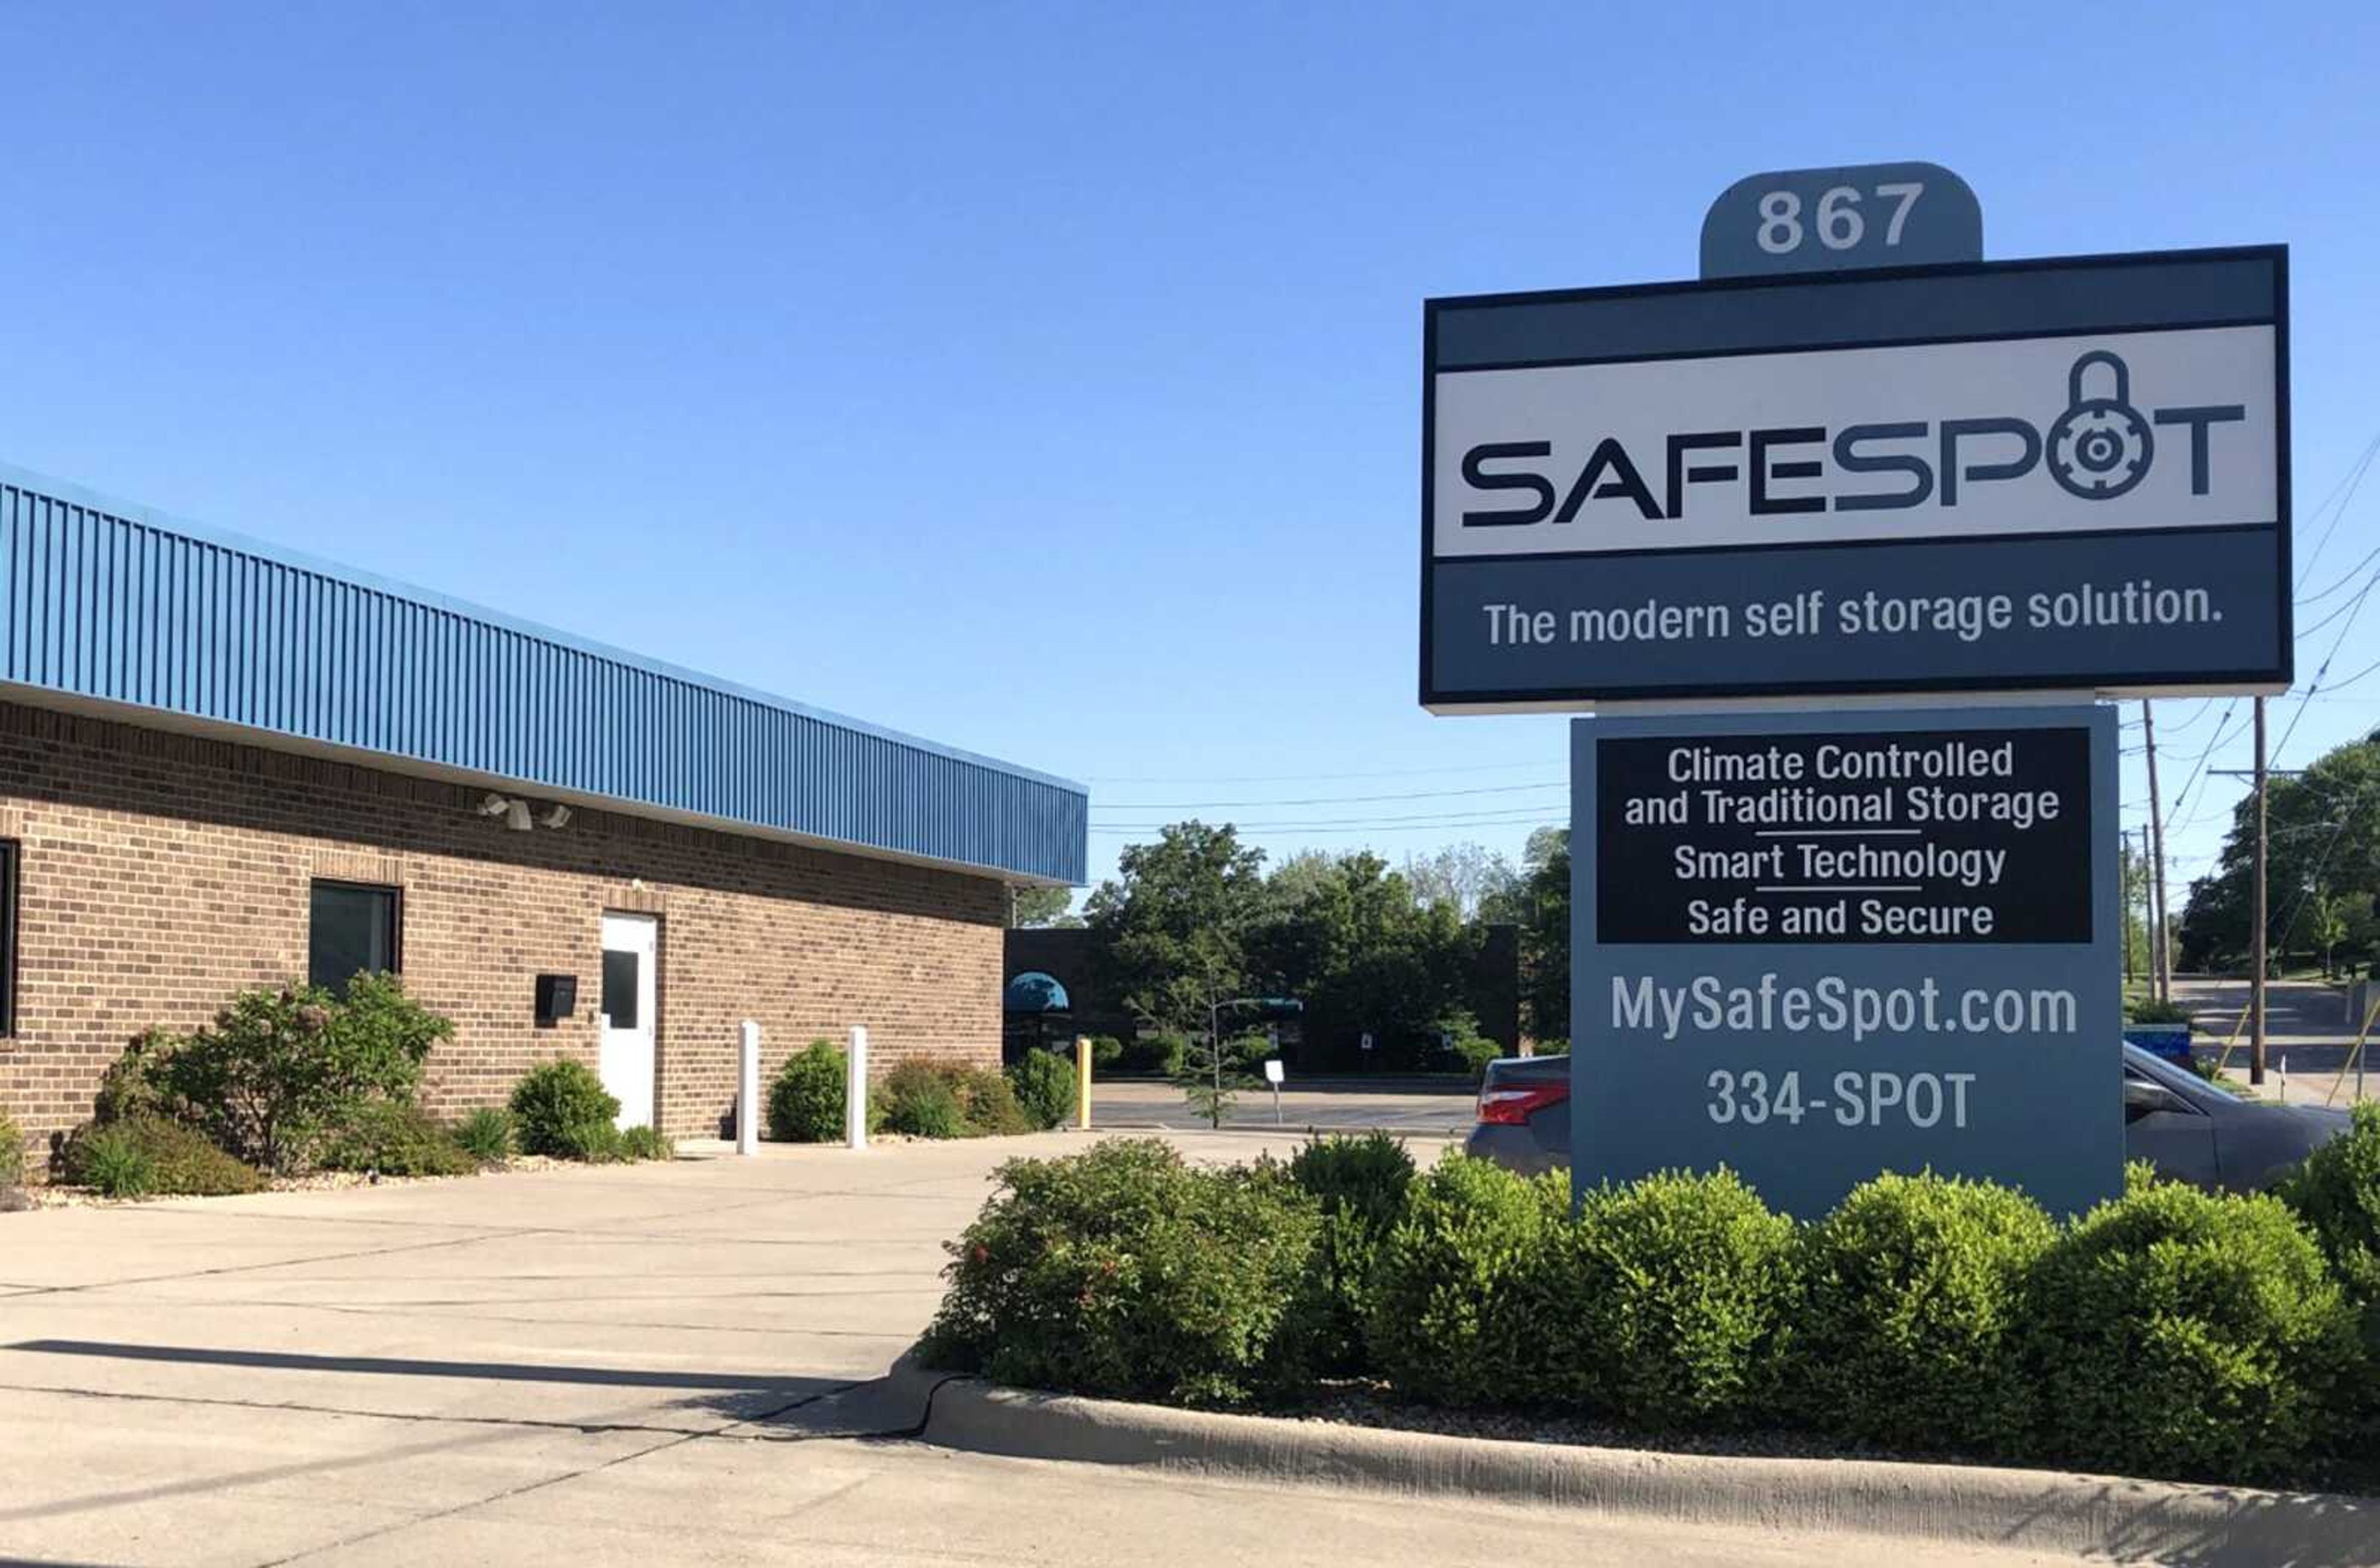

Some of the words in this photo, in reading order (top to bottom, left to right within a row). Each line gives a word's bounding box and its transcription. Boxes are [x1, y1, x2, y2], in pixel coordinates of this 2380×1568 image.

[1757, 182, 1923, 253] 867
[1483, 604, 1556, 645] The
[1571, 599, 1729, 642] modern
[1745, 590, 1823, 637] self
[1839, 591, 2012, 641] storage
[2029, 579, 2222, 628] solution.
[1668, 746, 1804, 782] Climate
[1816, 741, 2012, 779] Controlled
[1625, 790, 1688, 824] and
[1701, 786, 1892, 823] Traditional
[1907, 786, 2059, 829] Storage
[1675, 844, 1784, 879] Smart
[1796, 842, 2006, 888] Technology
[1688, 898, 1768, 935] Safe
[1781, 899, 1846, 934] and
[1861, 899, 1993, 935] Secure
[1612, 973, 2076, 1042] MySafeSpot.com
[1708, 1069, 1976, 1128] 334-SPOT
